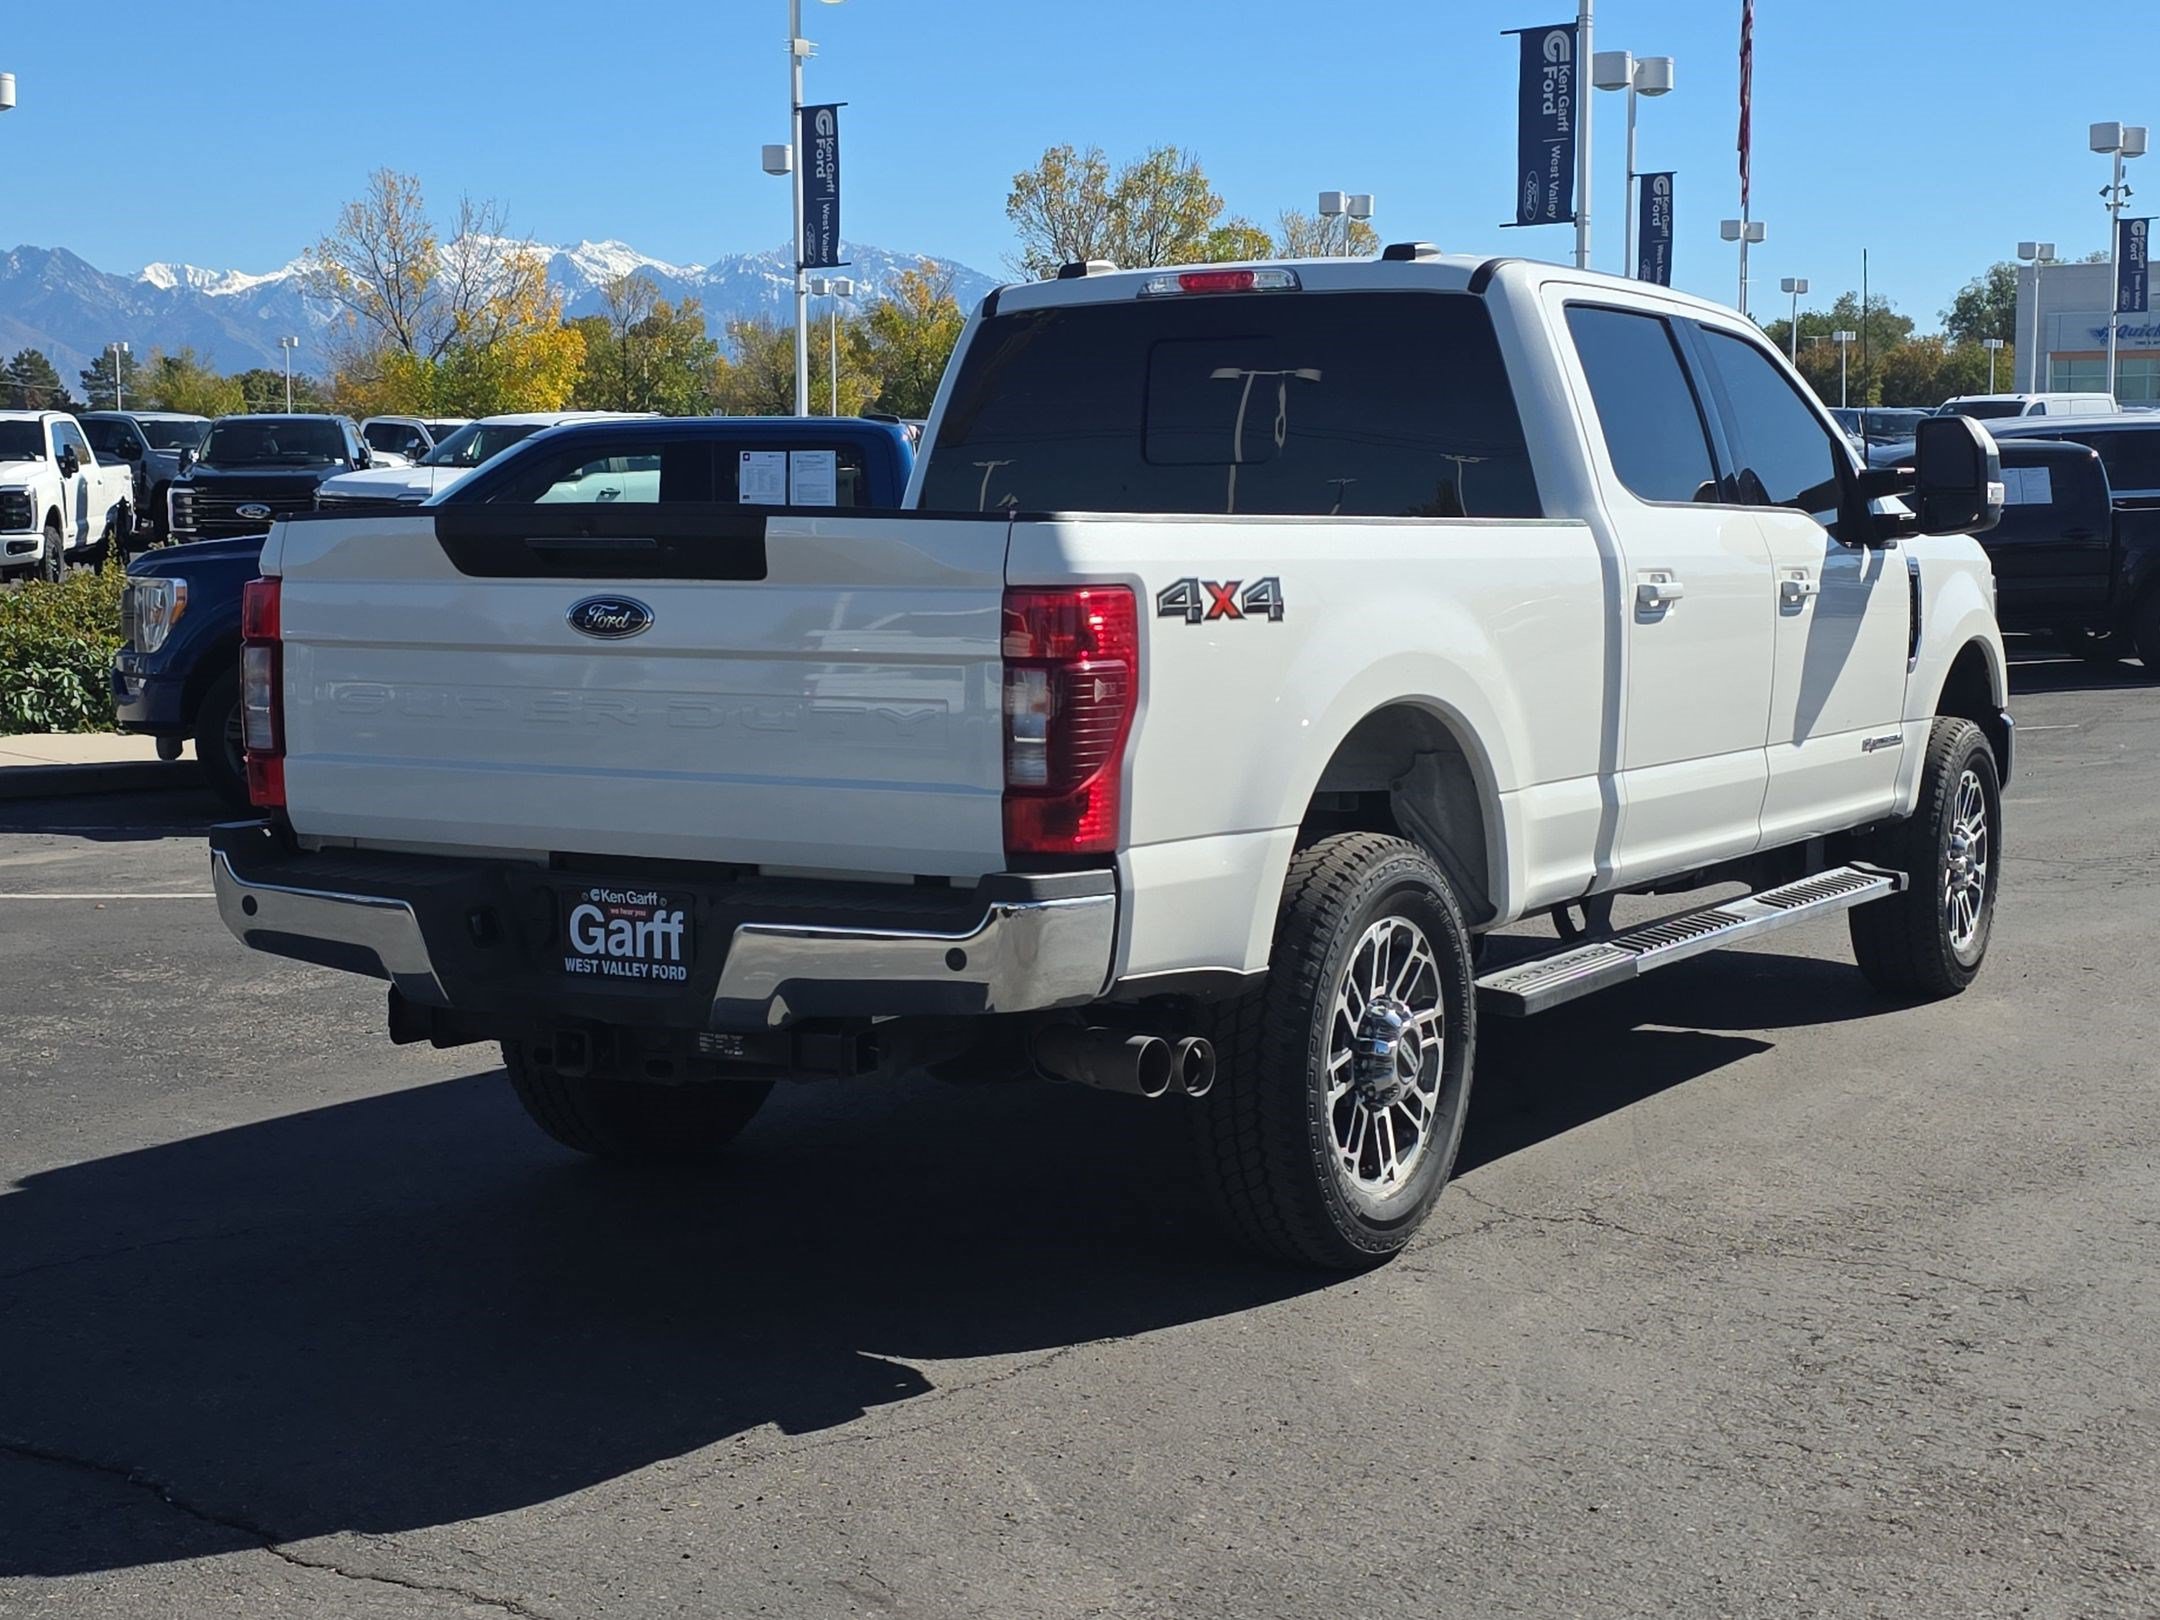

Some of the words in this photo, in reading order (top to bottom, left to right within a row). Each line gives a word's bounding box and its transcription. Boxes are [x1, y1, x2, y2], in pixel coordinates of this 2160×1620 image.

[1543, 66, 1557, 115] Ford
[1558, 64, 1571, 94] Ken
[1557, 95, 1570, 132] Garff
[816, 138, 826, 178] Ford
[826, 137, 834, 161] Ken
[1549, 145, 1561, 178] West
[826, 163, 835, 193] Garff
[1546, 181, 1559, 219] Valley
[1652, 197, 1661, 226] Ford
[822, 203, 830, 230] West
[821, 233, 830, 263] Valley
[2130, 237, 2138, 260] Ford
[584, 603, 631, 629] Ford
[665, 696, 939, 738] DUTY
[600, 889, 626, 904] Ken
[626, 891, 658, 906] Garff
[570, 904, 684, 960] Garff
[564, 957, 599, 974] WEST
[601, 960, 649, 979] VALLEY
[652, 964, 687, 980] FORD
